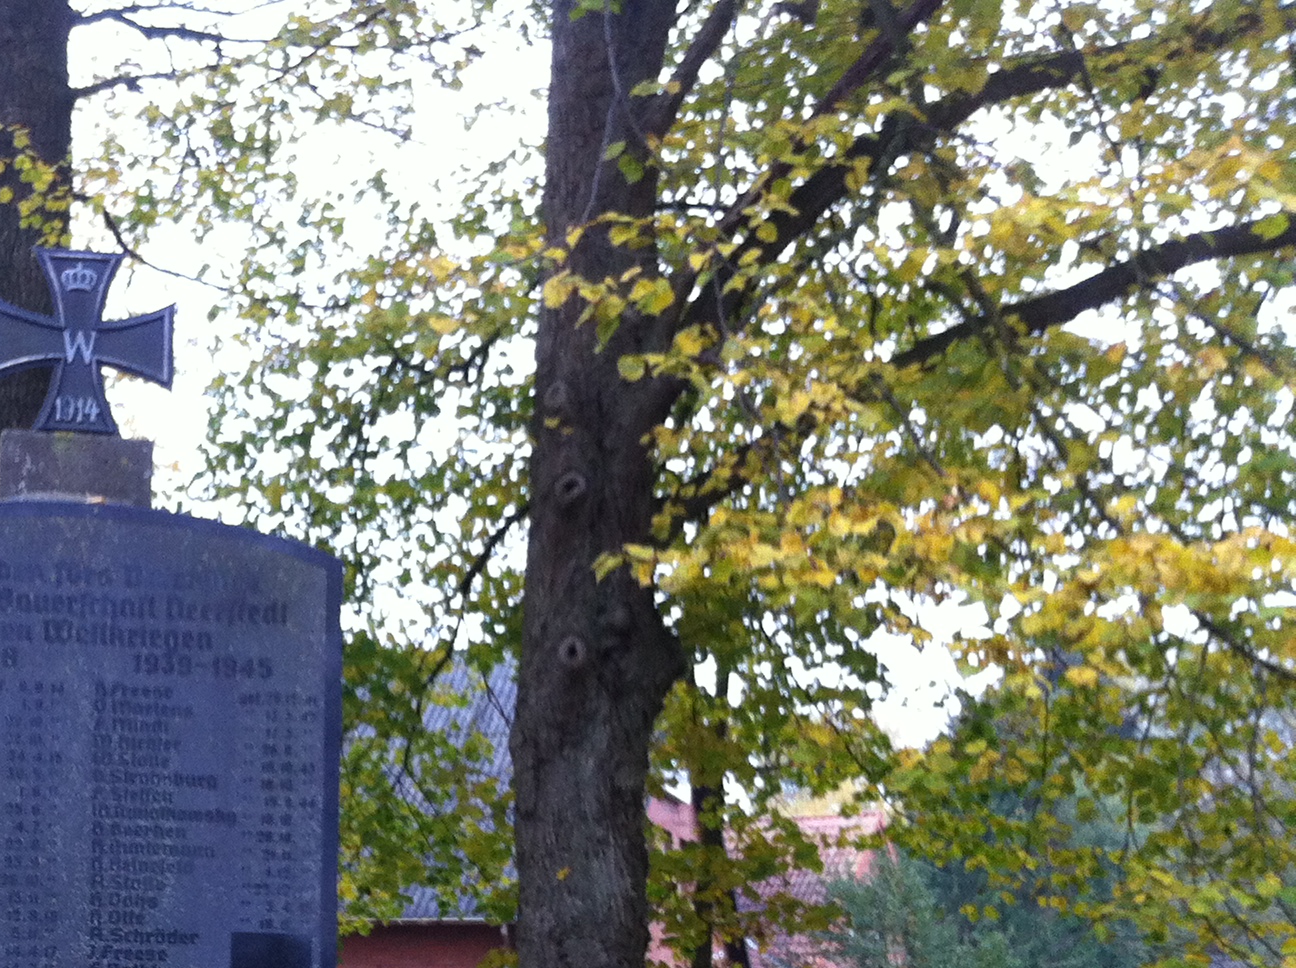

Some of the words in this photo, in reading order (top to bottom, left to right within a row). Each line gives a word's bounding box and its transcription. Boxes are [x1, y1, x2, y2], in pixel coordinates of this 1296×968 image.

[63, 329, 97, 365] W
[55, 397, 100, 423] 1914
[43, 618, 213, 656] Weltkriegen
